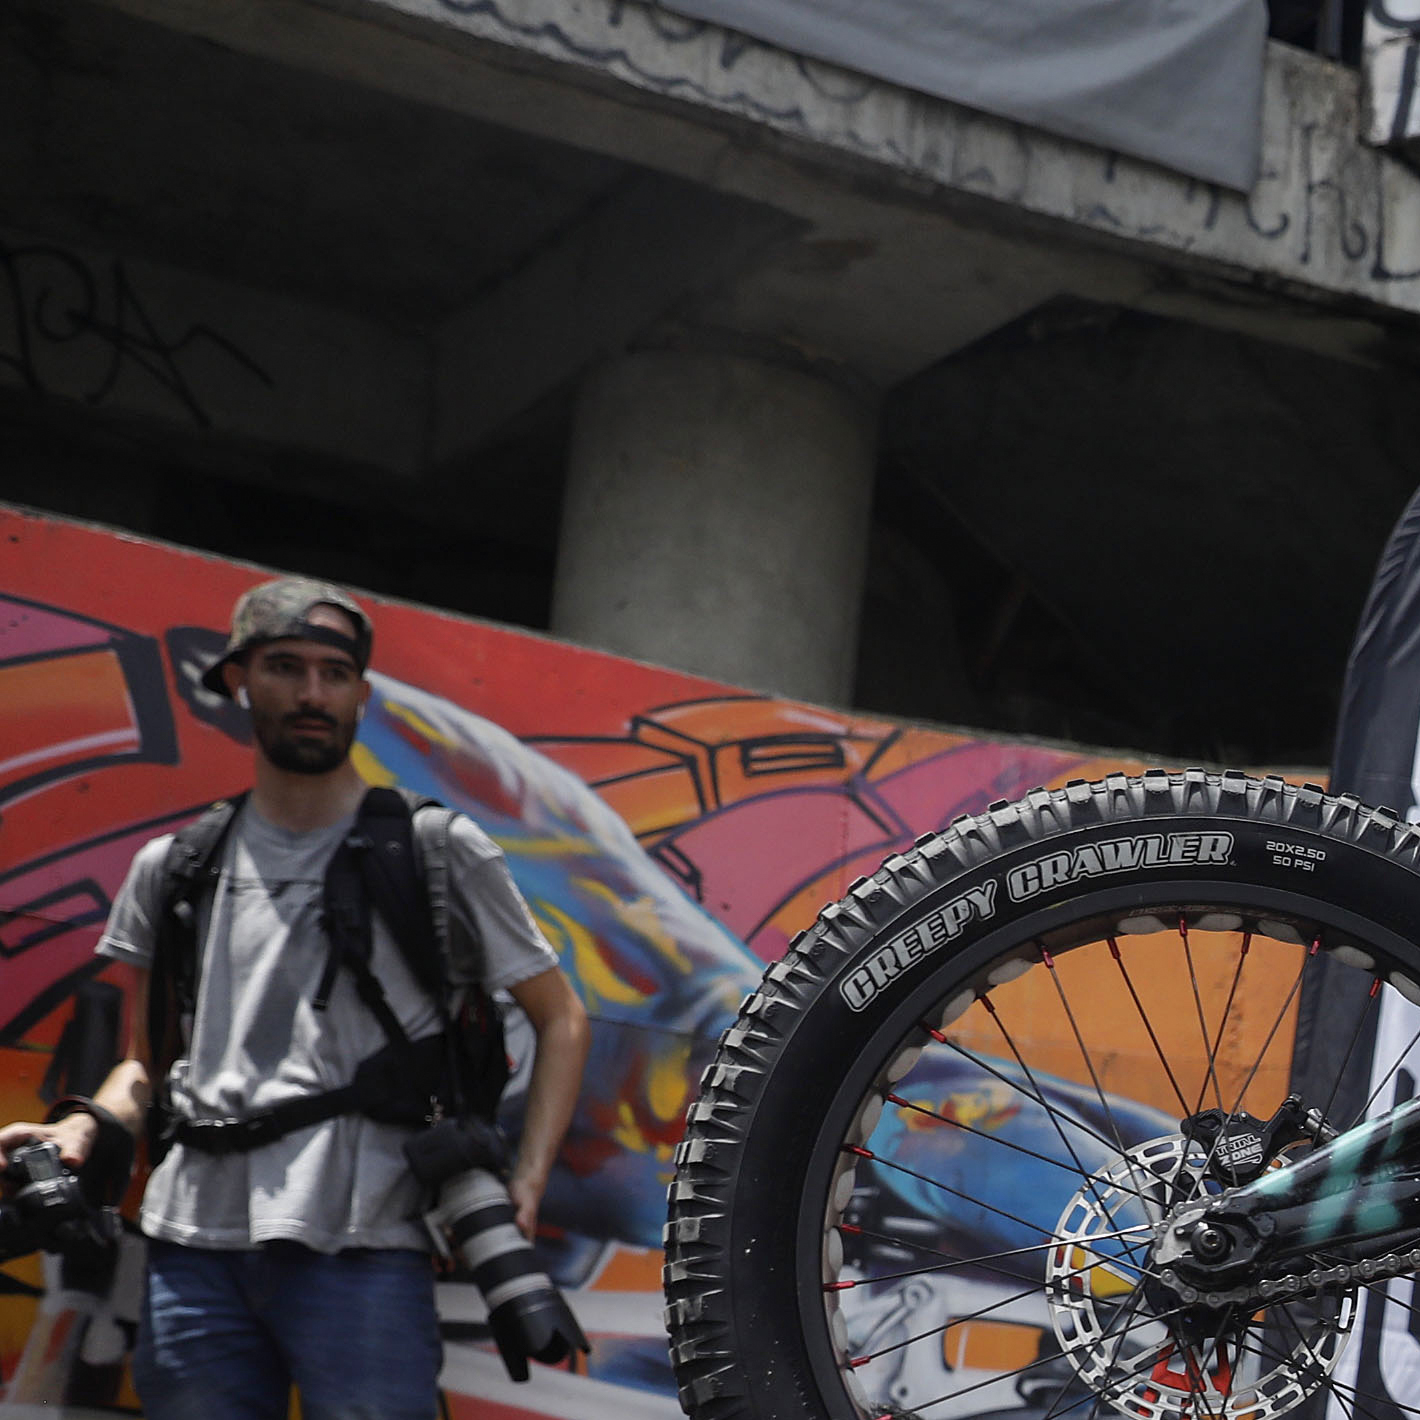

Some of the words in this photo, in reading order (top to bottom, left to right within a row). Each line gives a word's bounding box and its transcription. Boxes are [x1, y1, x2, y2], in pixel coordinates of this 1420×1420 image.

[1265, 840, 1327, 862] 20X2.50
[1272, 854, 1292, 869] 50
[1294, 856, 1316, 872] PSI
[839, 879, 998, 1012] CREEPY
[1006, 831, 1236, 903] CRAWLER
